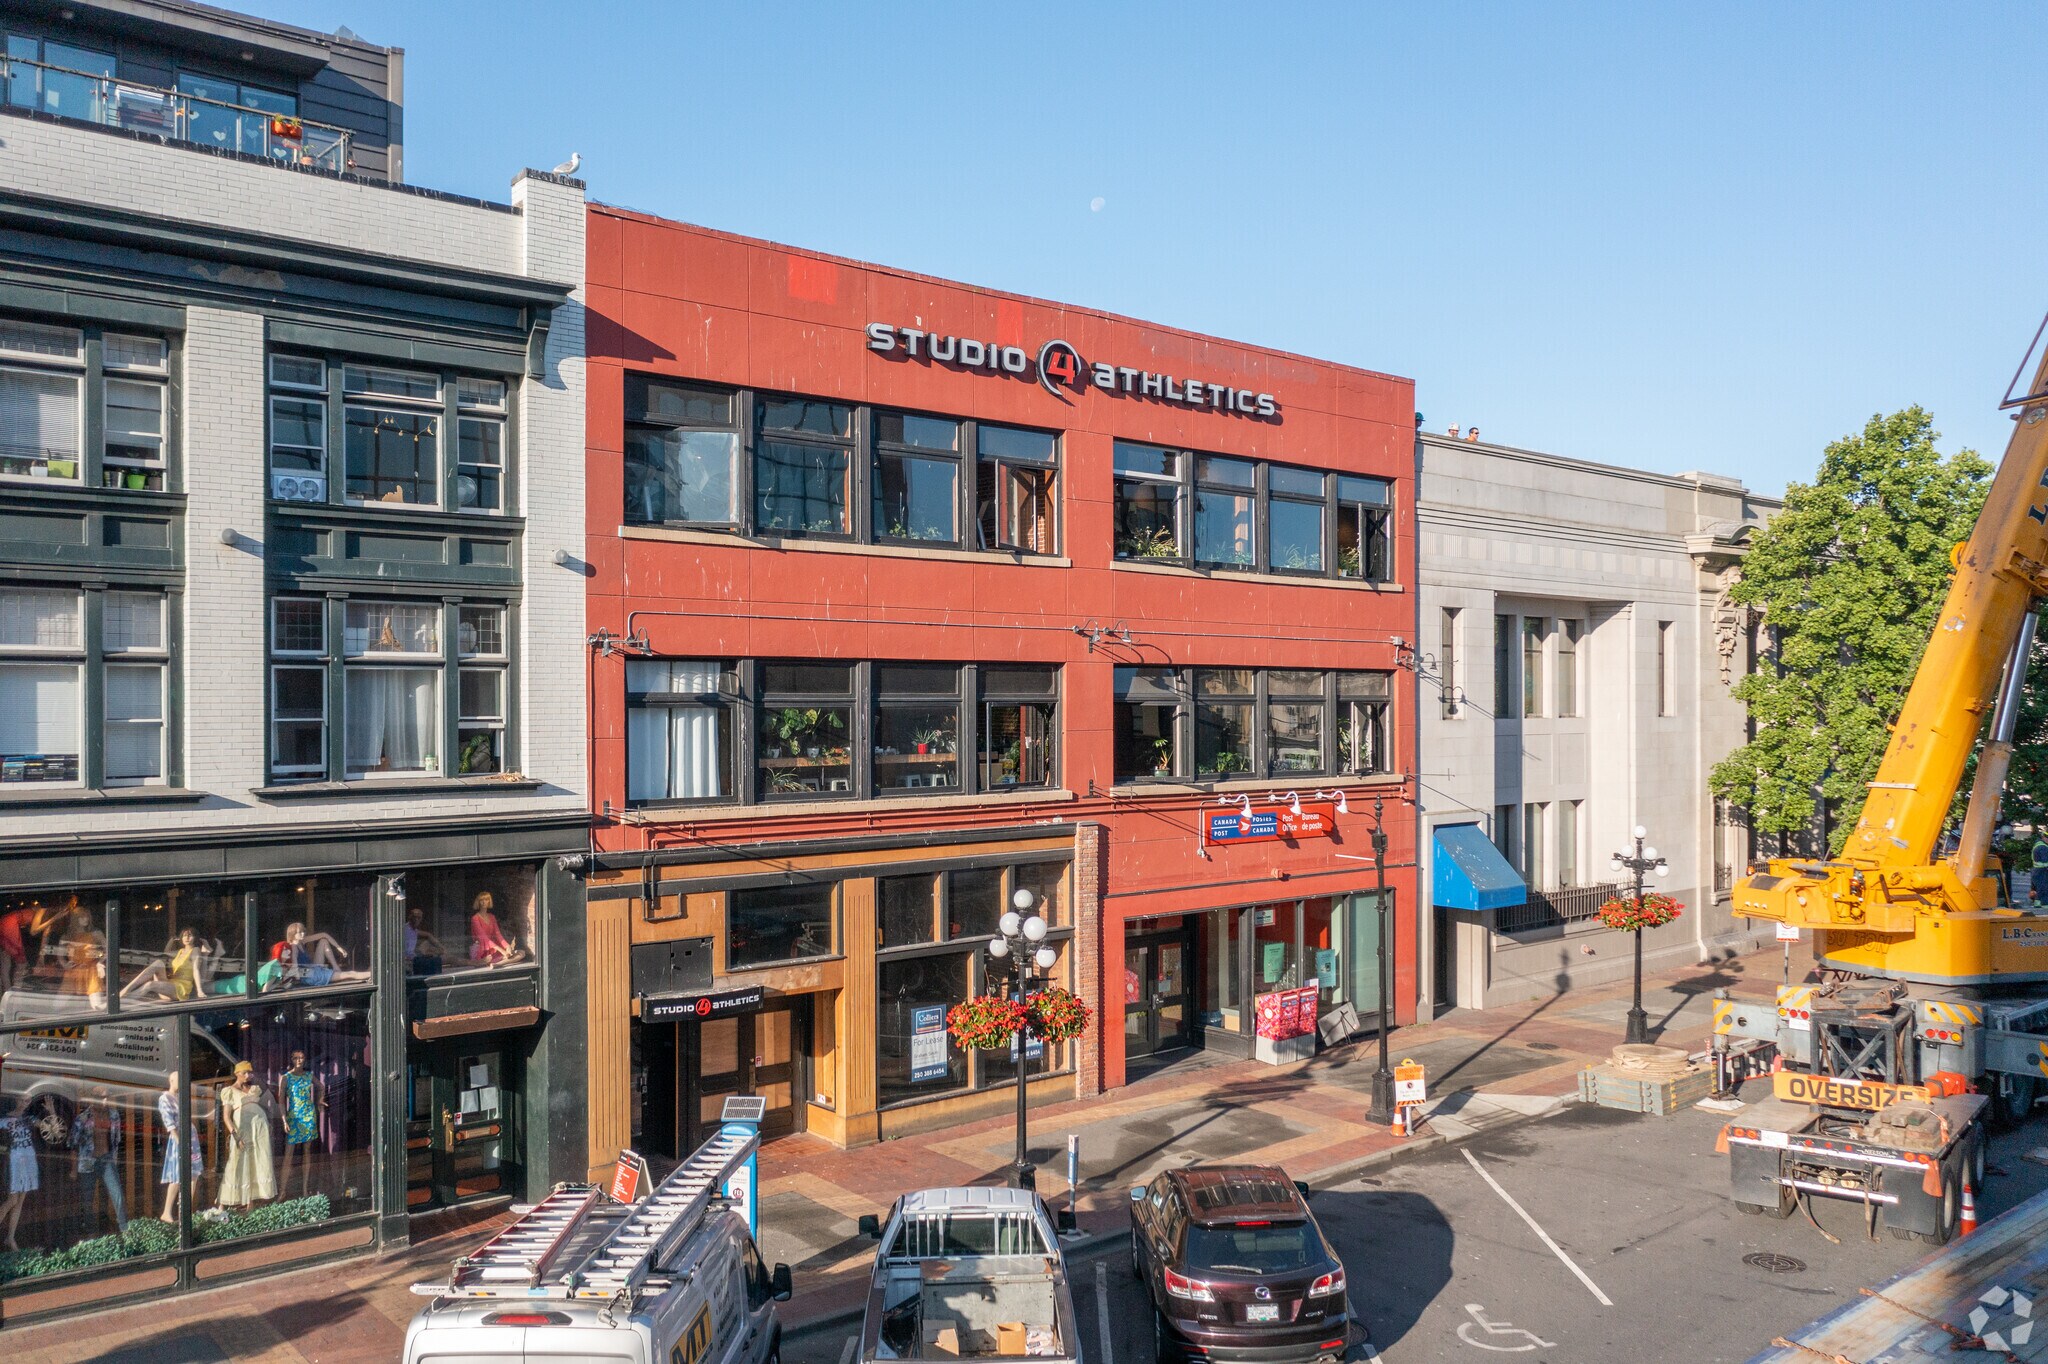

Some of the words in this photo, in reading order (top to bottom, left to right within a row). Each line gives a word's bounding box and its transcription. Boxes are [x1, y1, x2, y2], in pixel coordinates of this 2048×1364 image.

[866, 322, 1026, 373] STUDIO
[1282, 814, 1294, 822] Post
[1301, 812, 1320, 821] Bureau
[1213, 818, 1237, 826] CANADA
[1301, 822, 1309, 831] de
[1309, 822, 1323, 831] poste
[1252, 826, 1275, 834] CANADA
[1854, 931, 1893, 955] TON
[653, 1004, 695, 1015] STUDIO
[918, 1013, 939, 1022] Colliers
[913, 1038, 923, 1046] For
[925, 1036, 943, 1045] Lease
[914, 1071, 923, 1079] 250
[933, 1067, 945, 1075] 6454
